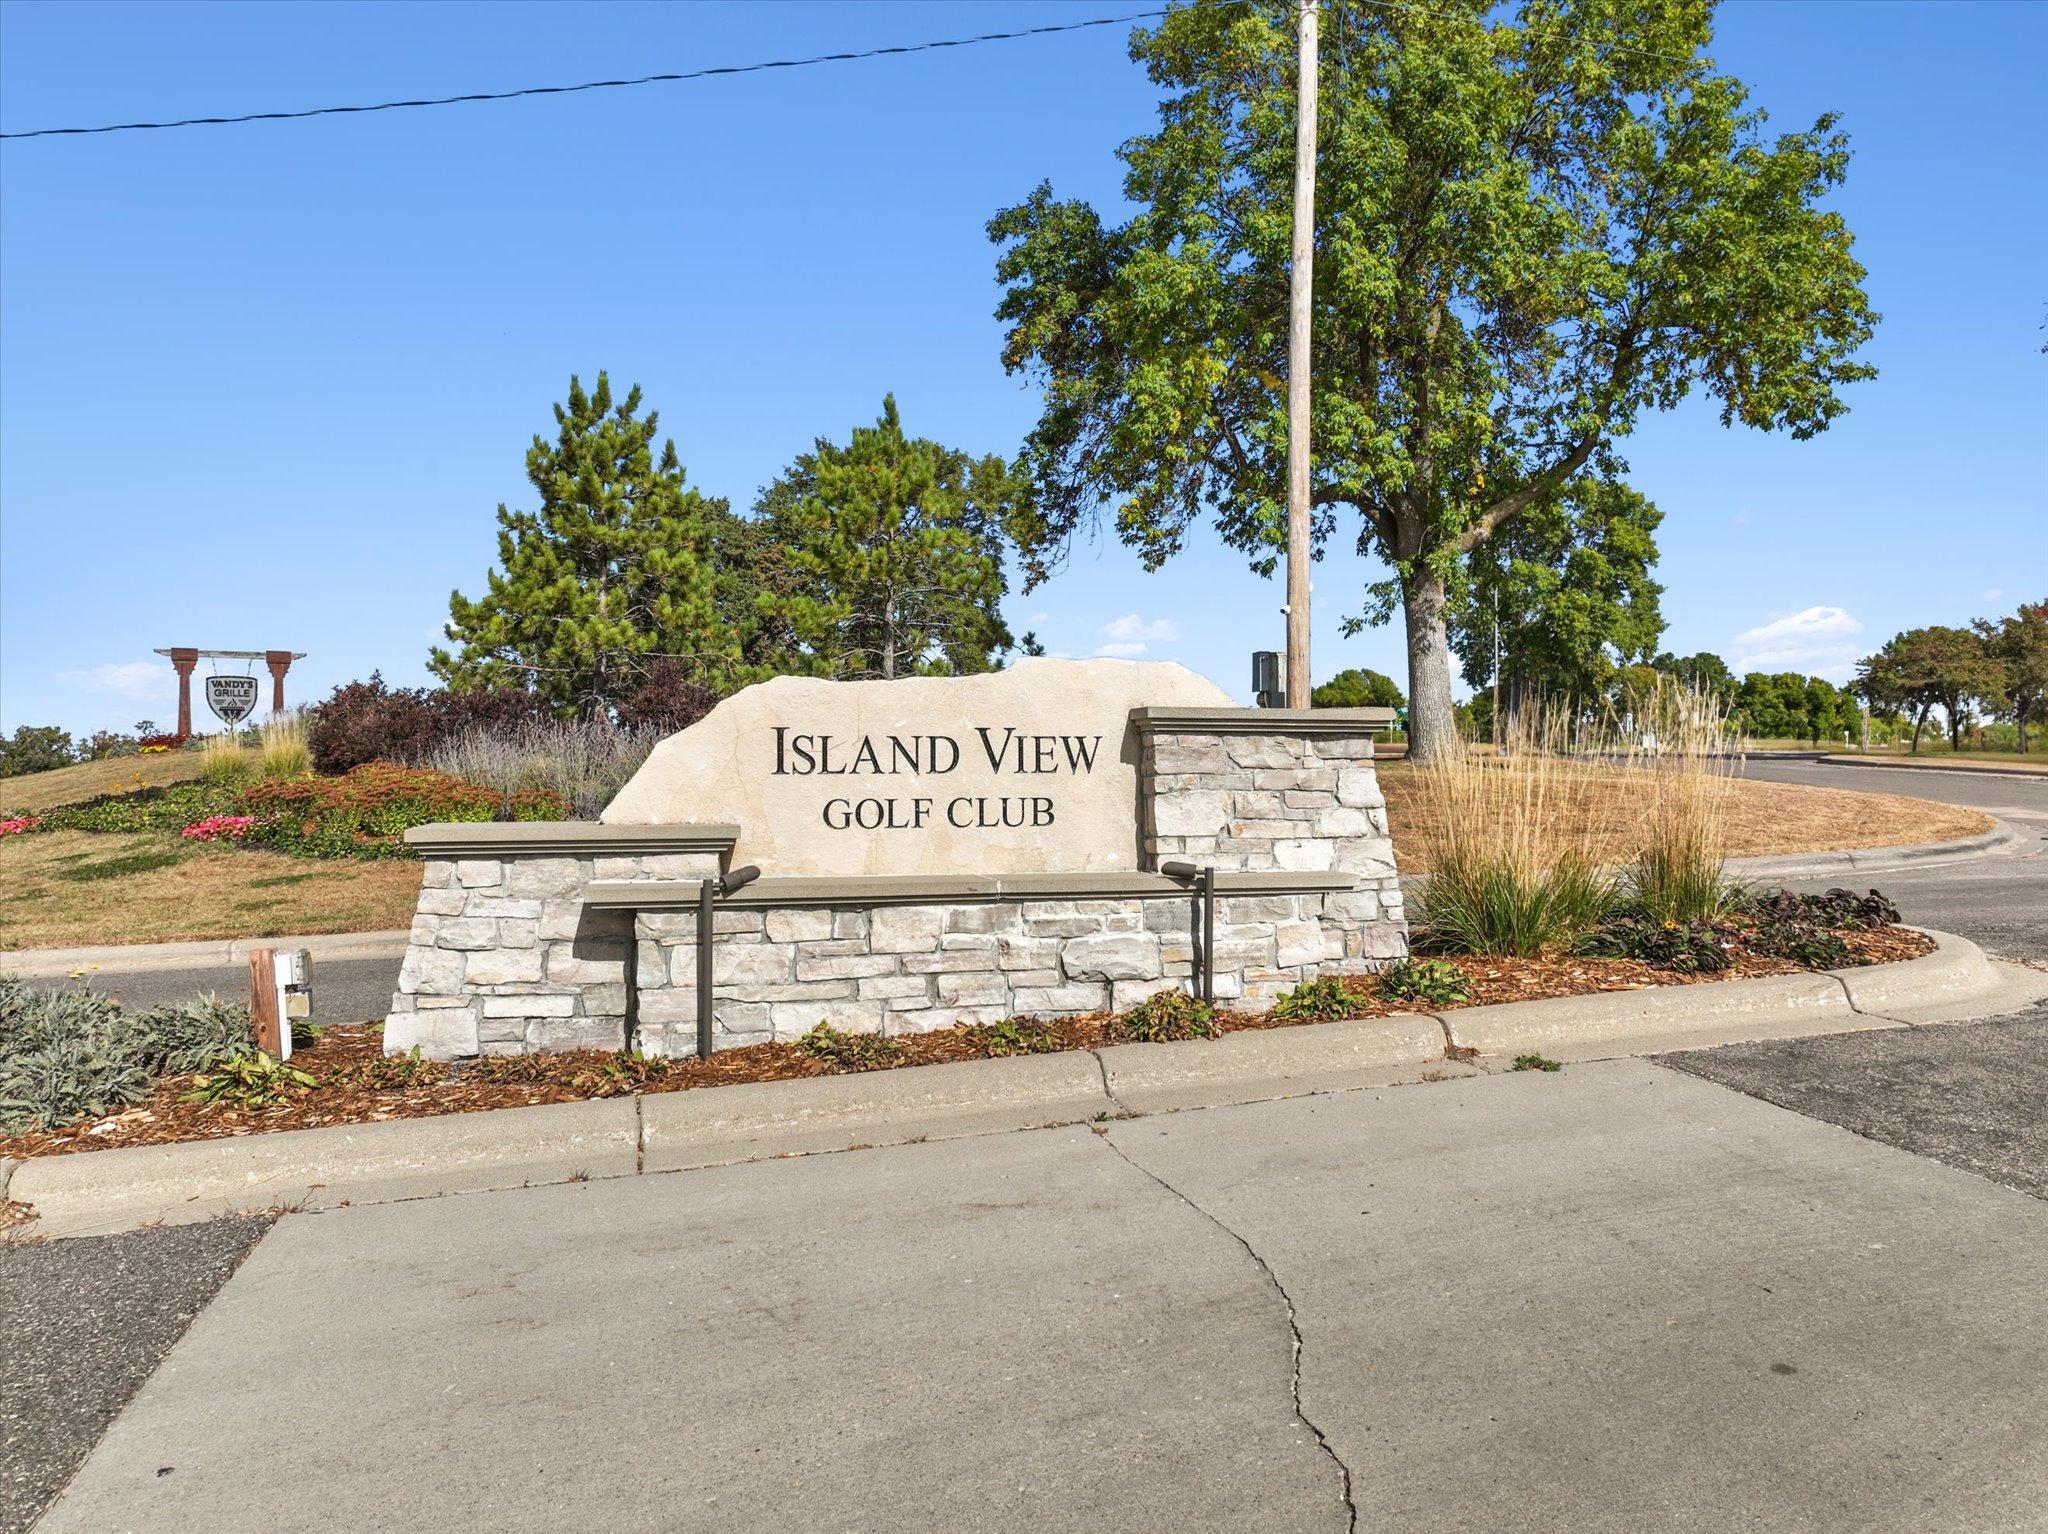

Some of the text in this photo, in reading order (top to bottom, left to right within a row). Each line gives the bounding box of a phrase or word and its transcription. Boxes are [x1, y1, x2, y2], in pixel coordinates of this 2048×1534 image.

[211, 680, 253, 688] VANDY'S
[214, 689, 250, 697] GRILLE
[770, 726, 1103, 776] ISLAND VIEW
[822, 797, 1055, 830] GOLF CLUB
